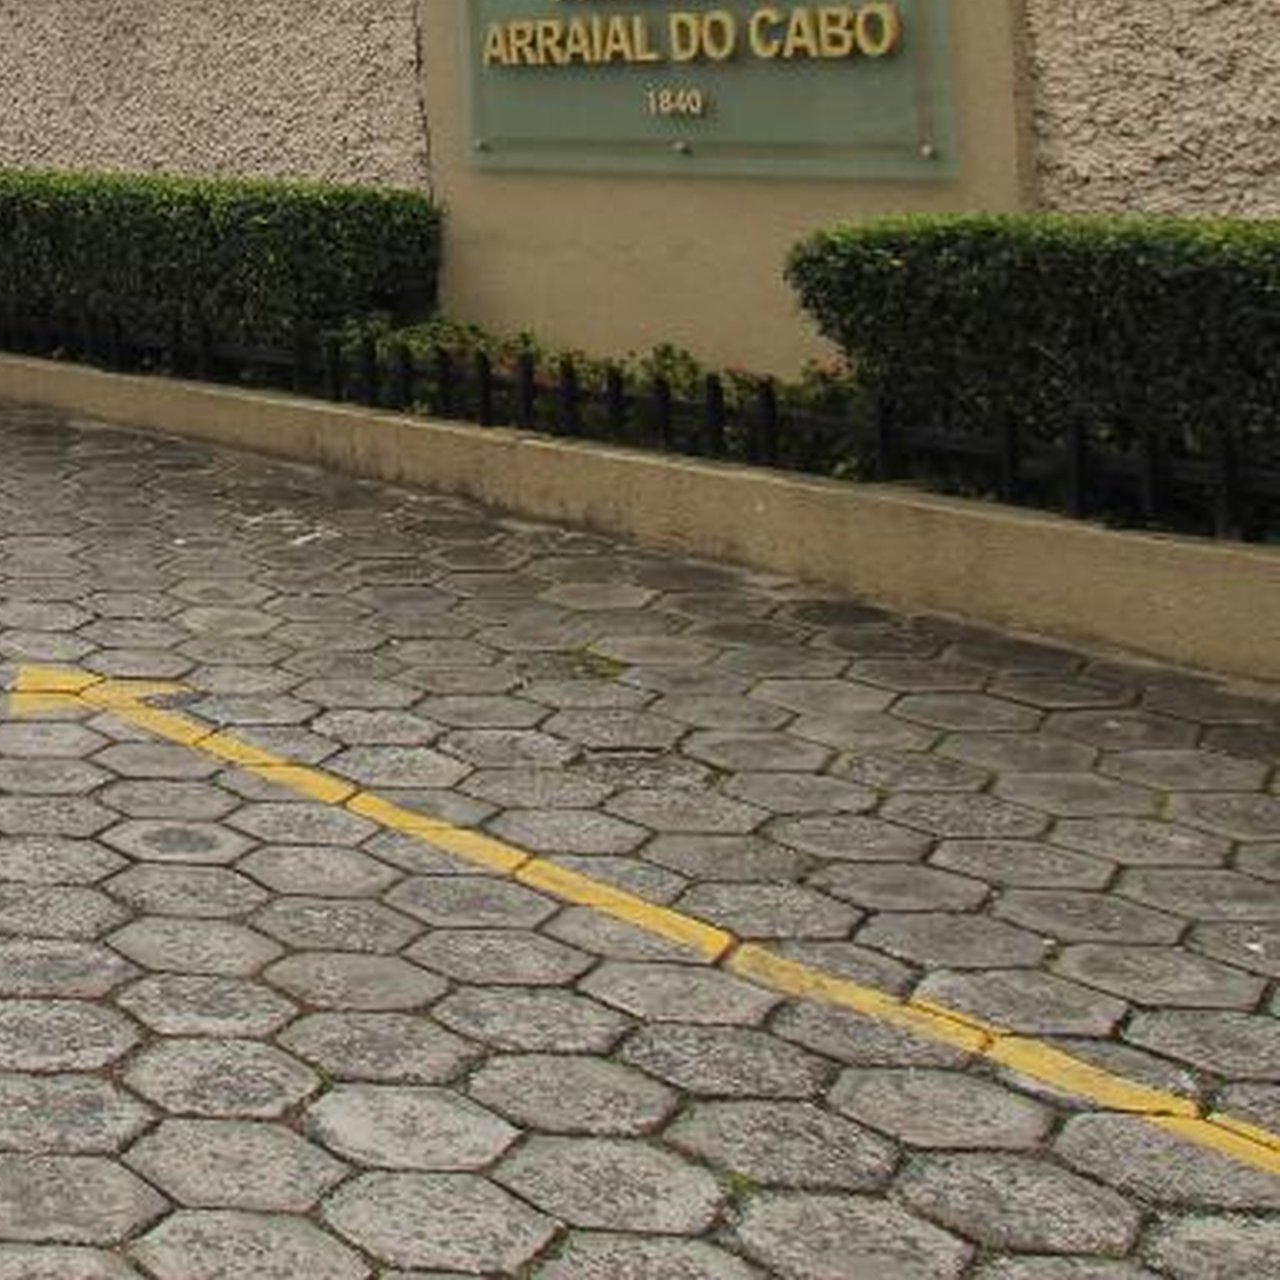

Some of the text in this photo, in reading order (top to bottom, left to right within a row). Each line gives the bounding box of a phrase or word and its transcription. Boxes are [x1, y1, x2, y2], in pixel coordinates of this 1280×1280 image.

[481, 0, 903, 66] ARRAIAL DO CABO
[647, 87, 703, 115] 1840
